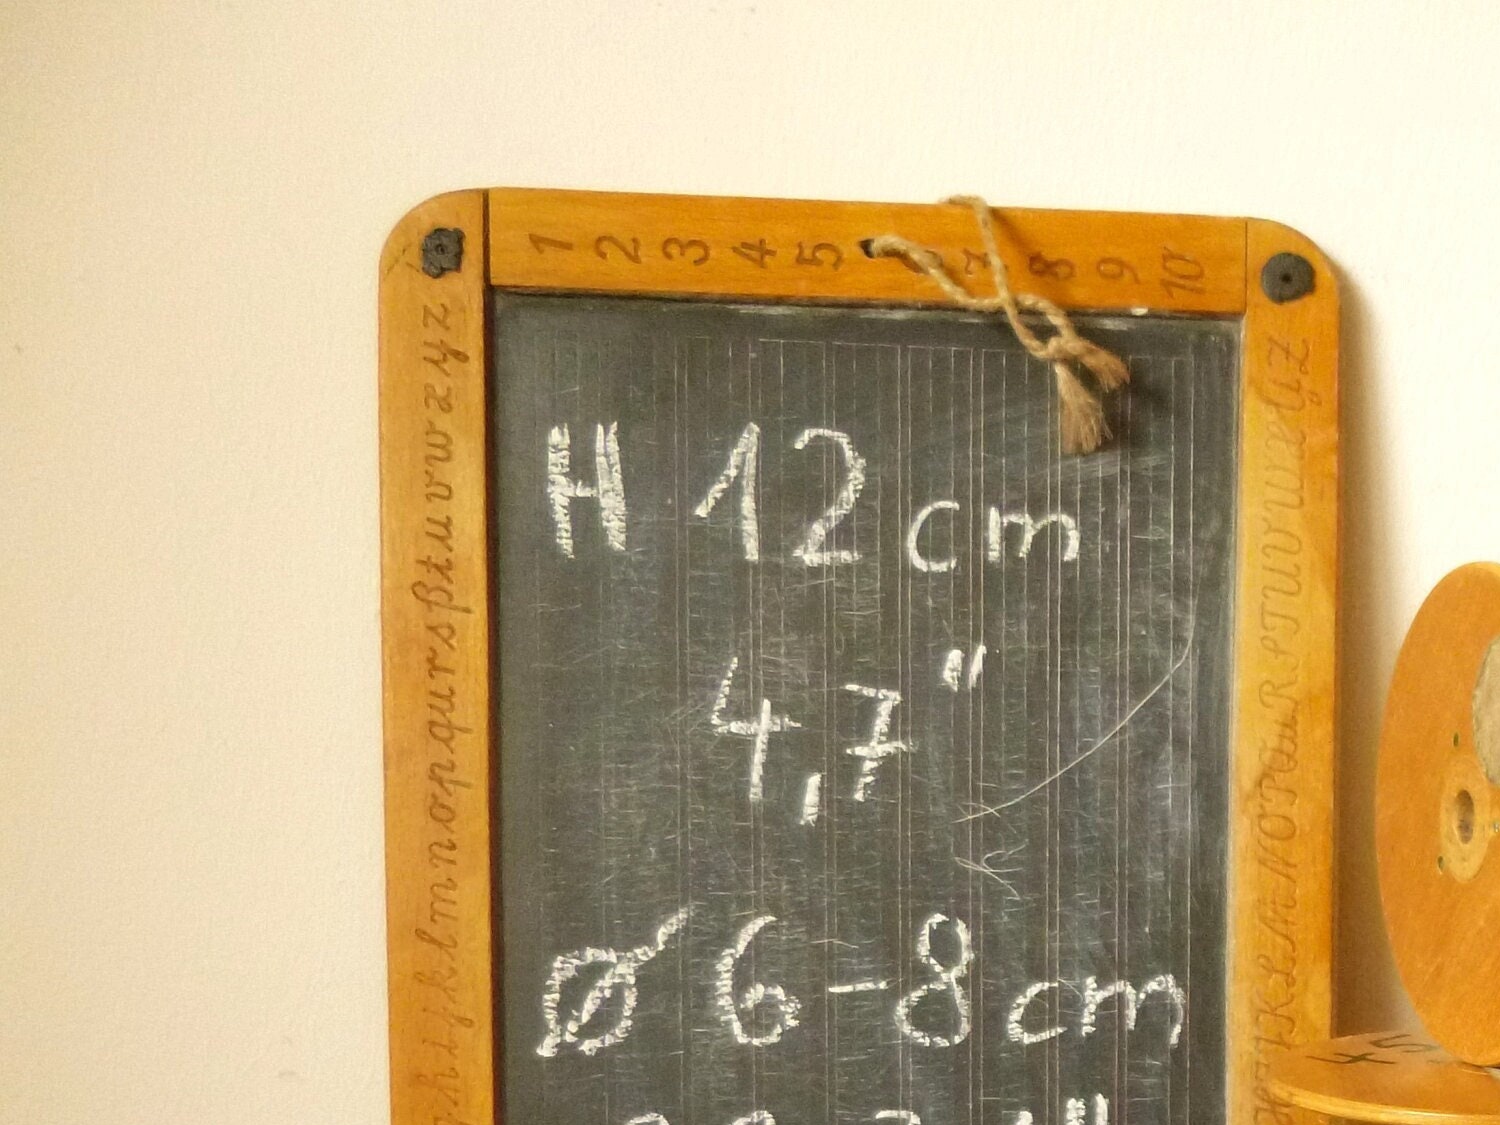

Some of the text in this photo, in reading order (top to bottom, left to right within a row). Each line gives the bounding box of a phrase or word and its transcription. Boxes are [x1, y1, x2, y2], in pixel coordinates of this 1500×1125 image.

[528, 231, 574, 256] 1
[594, 233, 642, 263] 2
[661, 235, 711, 266] 3
[730, 236, 778, 270] 4
[796, 241, 844, 272] 5
[1028, 250, 1077, 280] 8
[1095, 256, 1143, 284] 9
[1163, 245, 1208, 300] 10
[546, 421, 1081, 573] H 12 cm
[1006, 974, 1185, 1047] cm
